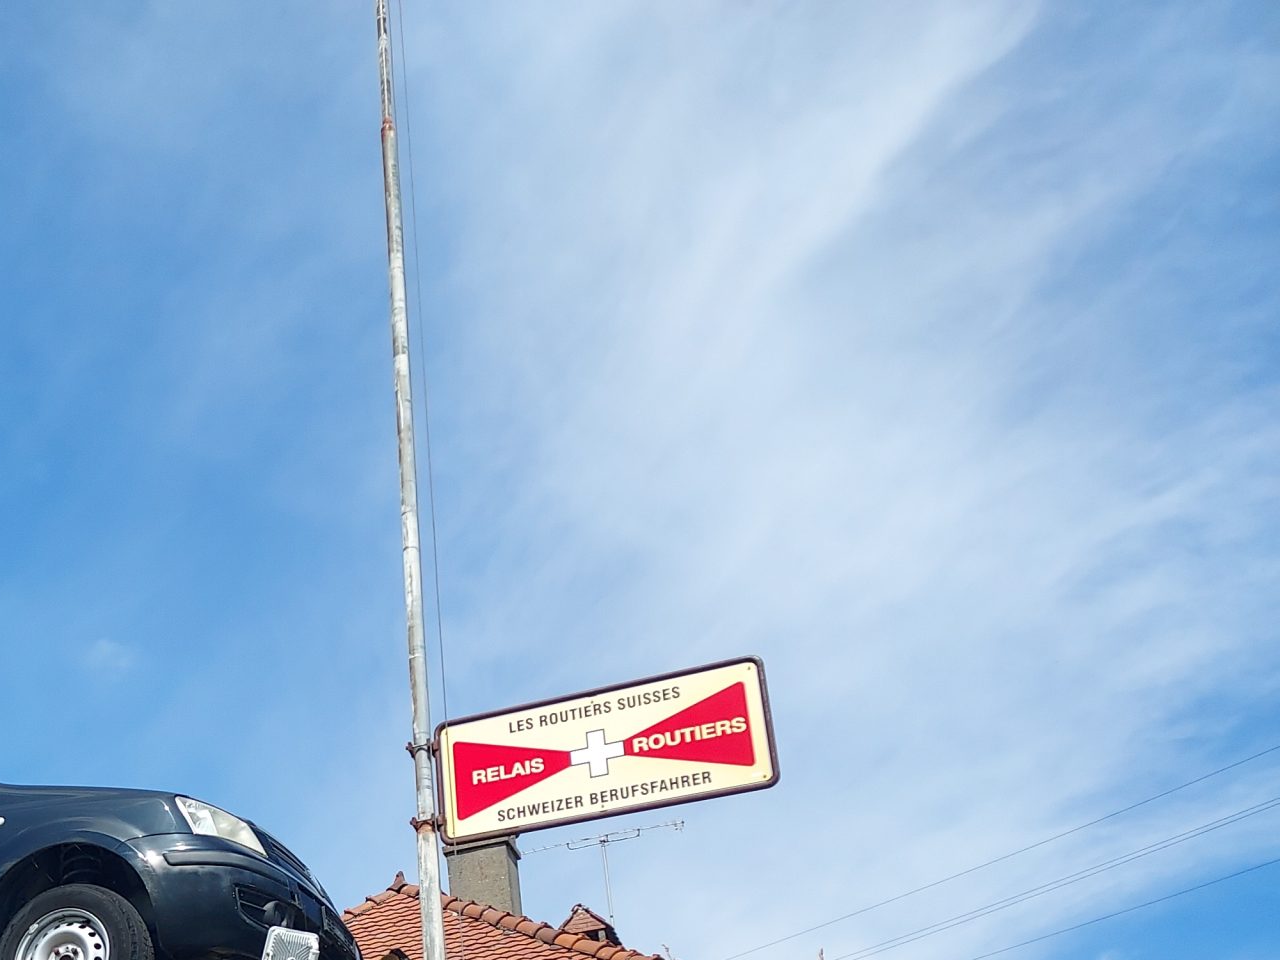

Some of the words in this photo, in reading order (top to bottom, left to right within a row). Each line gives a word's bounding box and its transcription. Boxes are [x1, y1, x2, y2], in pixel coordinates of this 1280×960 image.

[509, 718, 534, 733] LES
[539, 701, 612, 727] ROUTIERS
[617, 686, 681, 710] SUISSES
[632, 716, 748, 753] ROUTIERS
[472, 757, 544, 786] RELAIS
[497, 795, 585, 823] SCHWEIZER
[589, 771, 713, 805] BERUFSFAHRER
